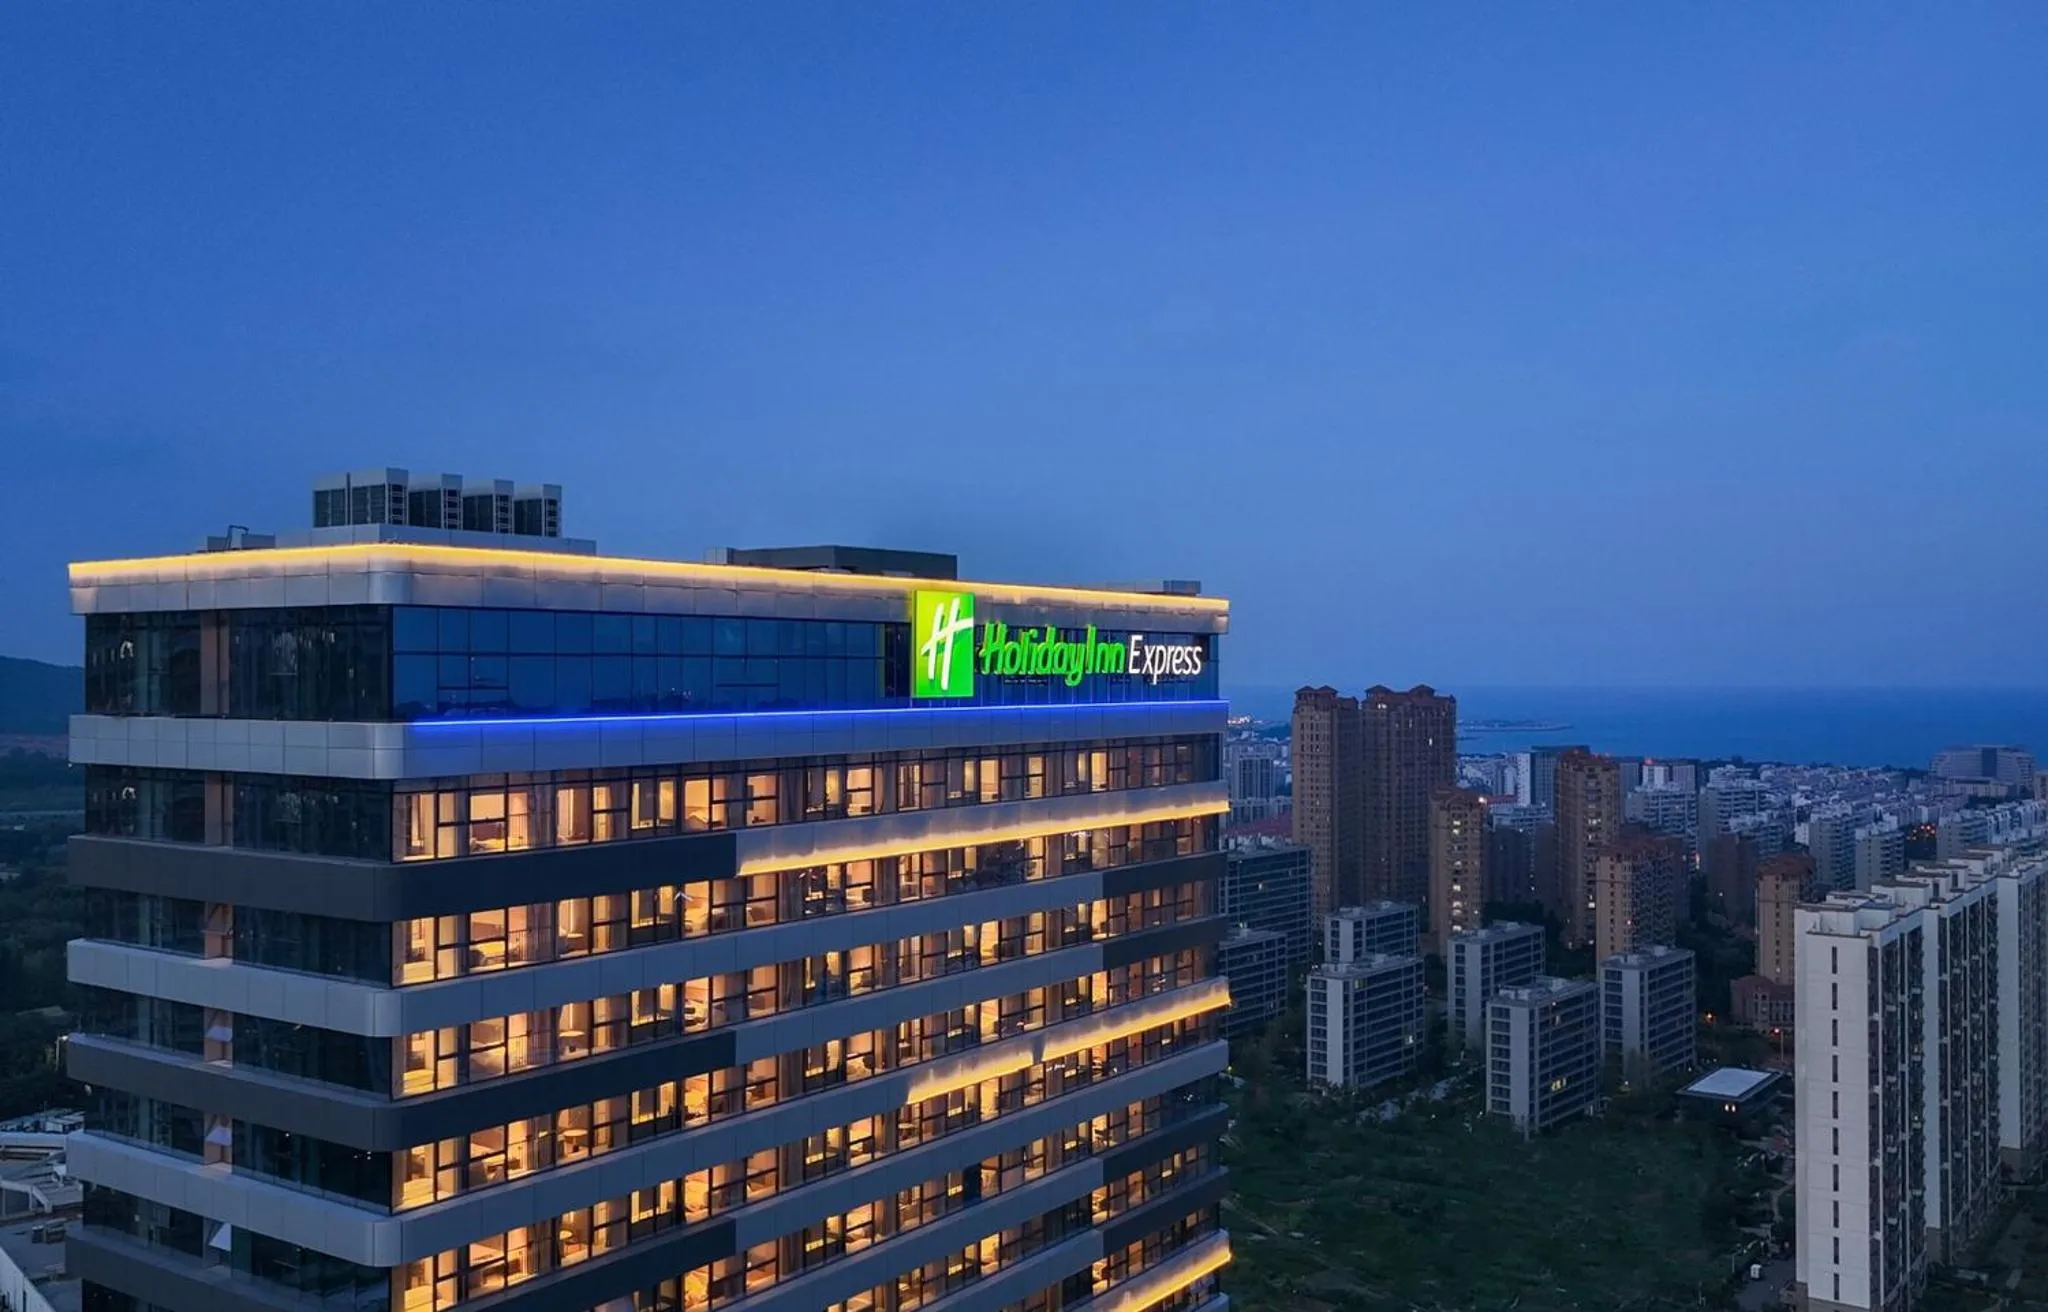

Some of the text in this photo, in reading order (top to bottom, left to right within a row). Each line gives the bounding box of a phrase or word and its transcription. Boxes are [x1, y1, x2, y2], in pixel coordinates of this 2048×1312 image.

[920, 597, 974, 691] H
[979, 622, 1085, 687] Holiday
[1128, 634, 1203, 685] Express
